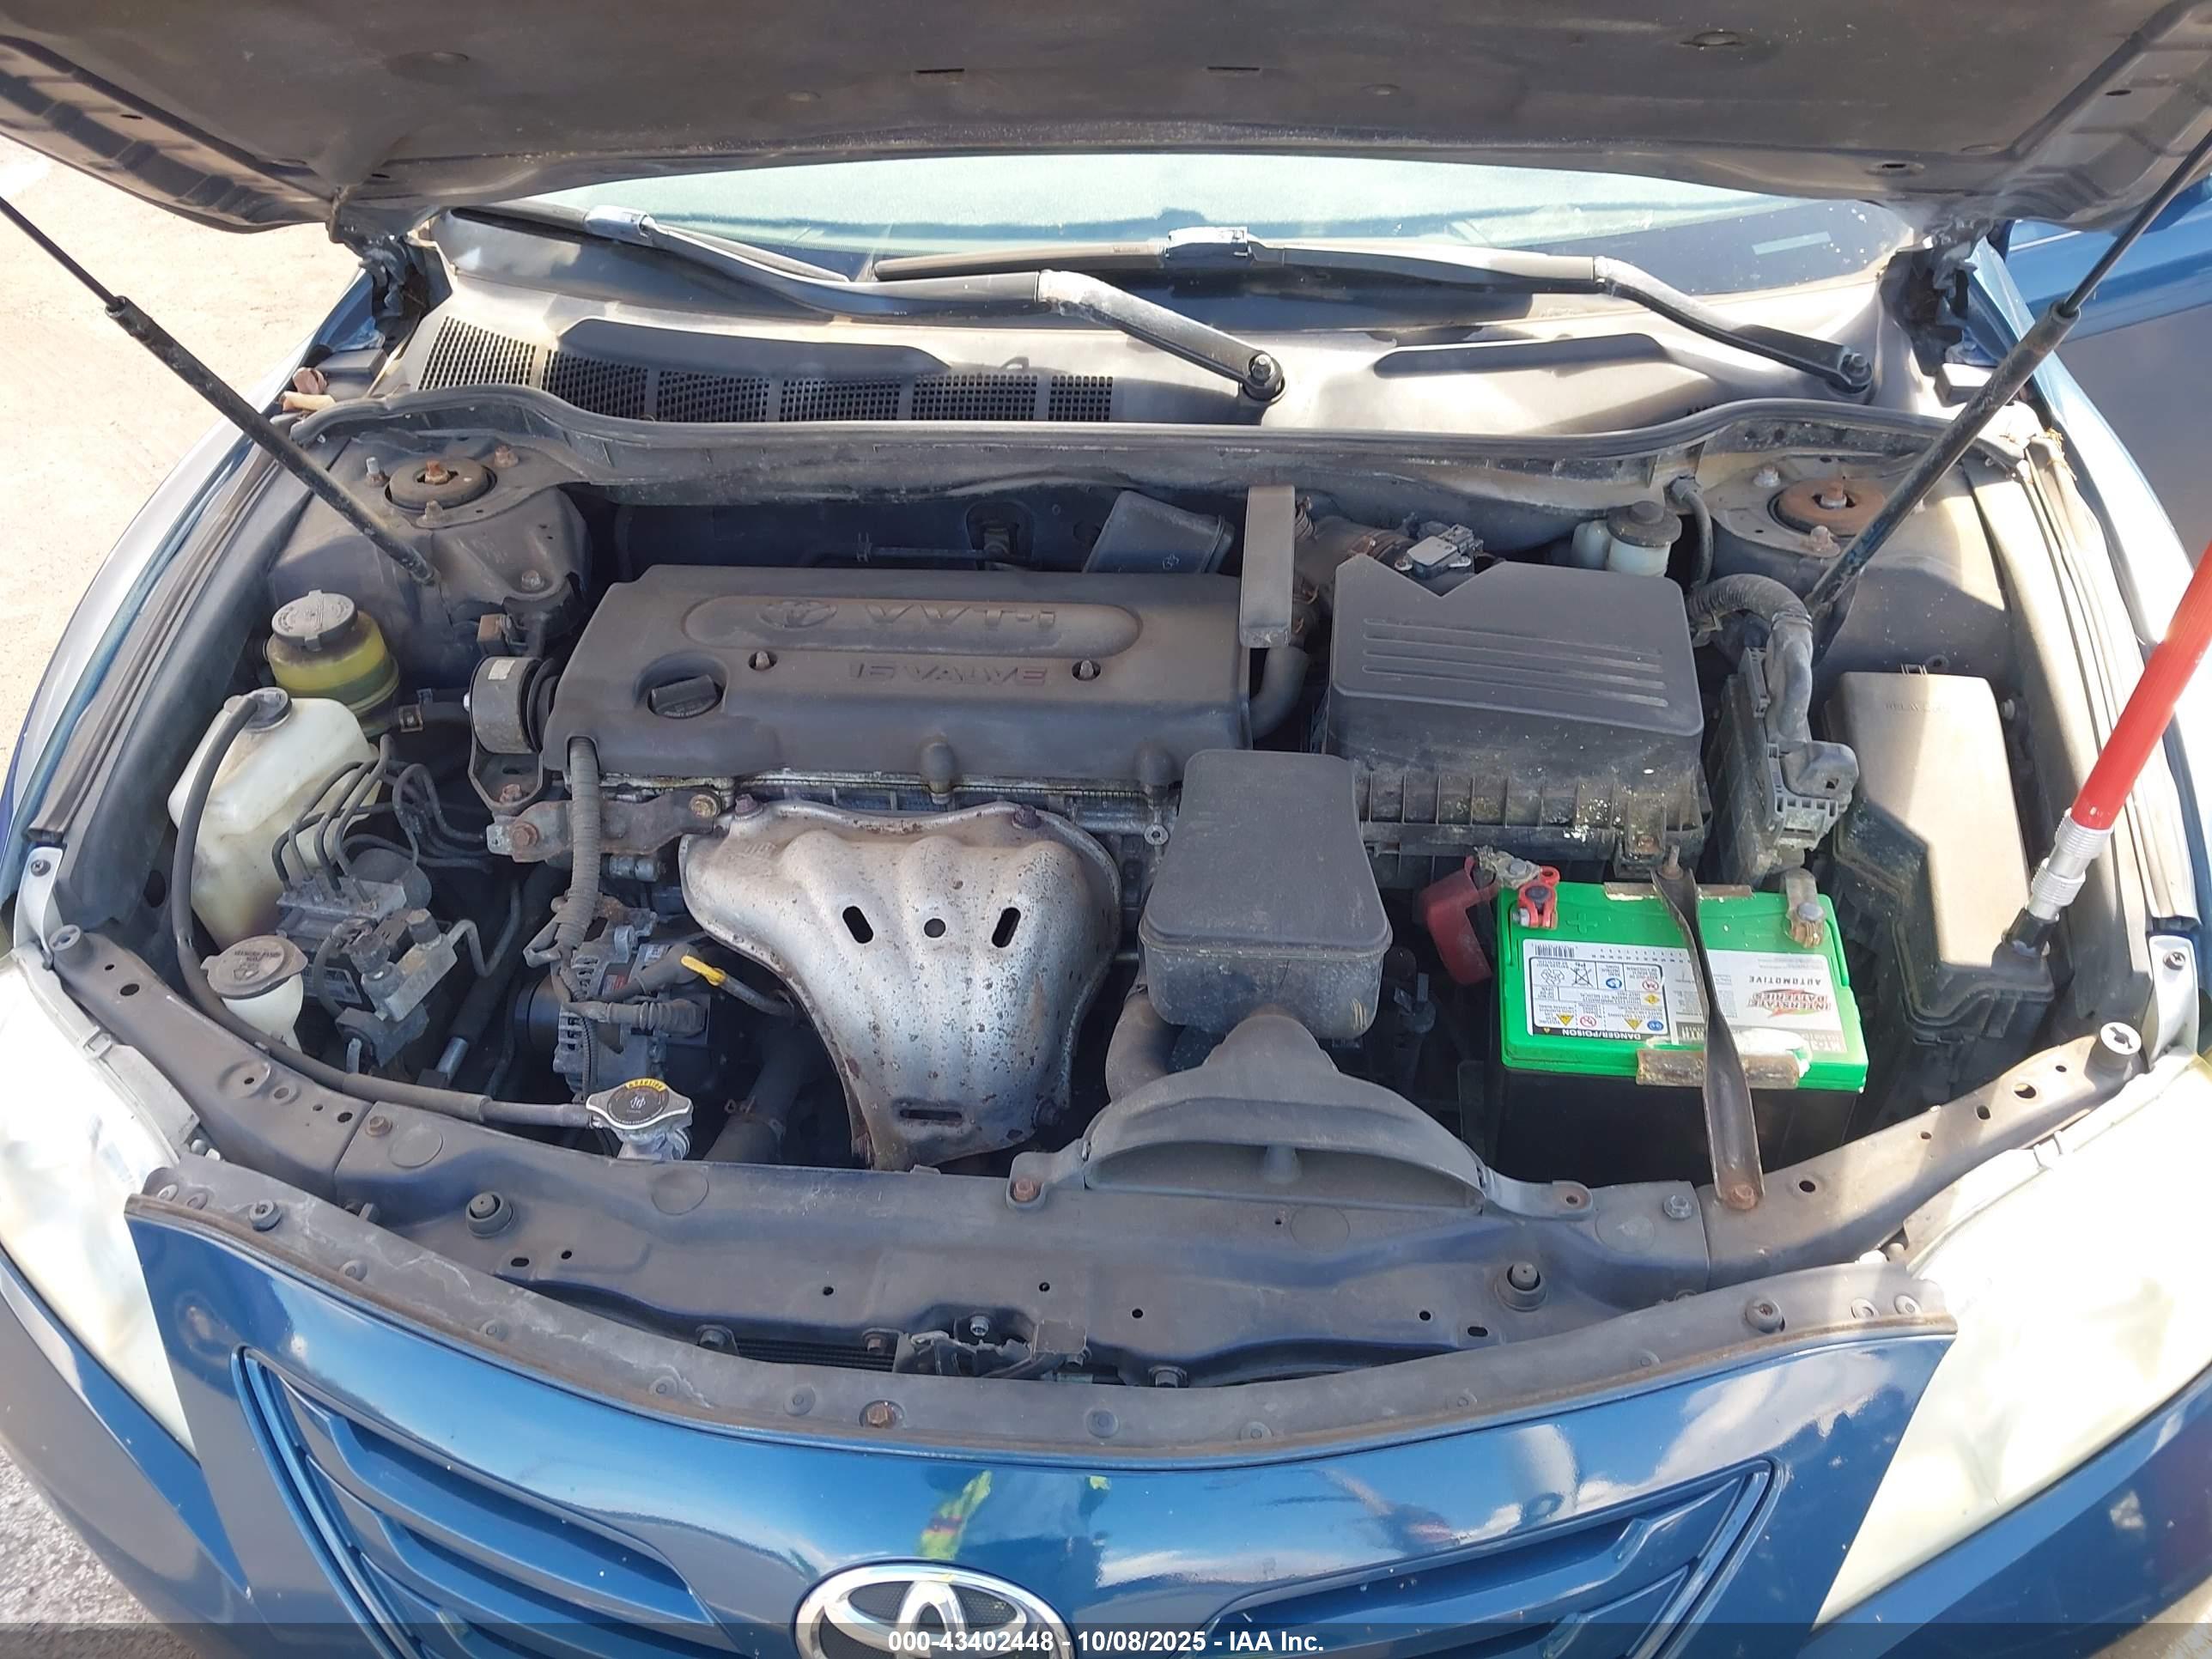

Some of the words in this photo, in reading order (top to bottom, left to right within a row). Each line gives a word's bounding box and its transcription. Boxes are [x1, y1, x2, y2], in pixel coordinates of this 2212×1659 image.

[903, 664, 1048, 685] VALVE
[1749, 975, 1821, 986] AUTOMOTIVE
[1561, 1029, 1642, 1040] DANGER/POISON
